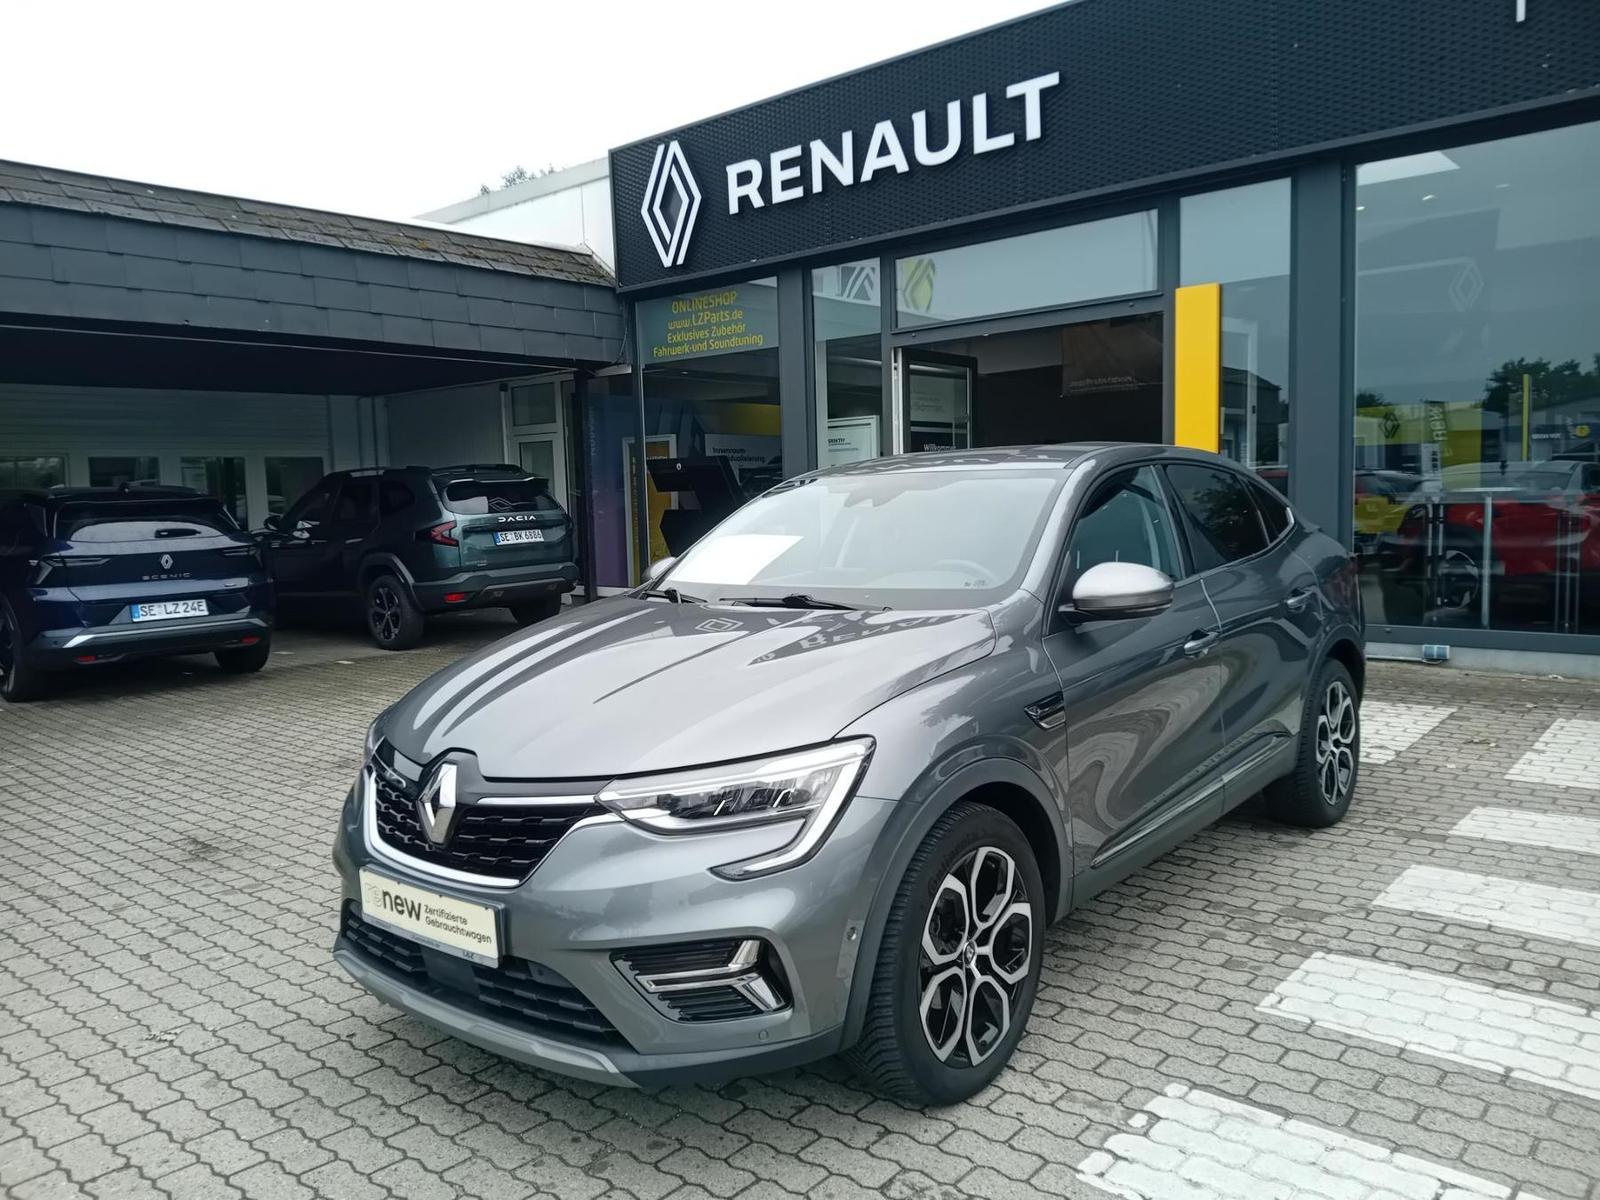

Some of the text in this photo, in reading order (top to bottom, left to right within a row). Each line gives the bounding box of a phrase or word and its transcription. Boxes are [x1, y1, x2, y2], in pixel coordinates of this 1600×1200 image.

[725, 71, 1060, 215] RENAULT
[671, 291, 738, 314] ONLINESHOP
[667, 309, 743, 330] www.LZParts.de
[667, 322, 746, 344] Exklusives Zubehör
[708, 334, 763, 351] Soundtuning
[498, 515, 537, 523] DACIA
[500, 533, 510, 542] SE
[513, 531, 525, 541] BK
[142, 572, 192, 581] SCENIC
[140, 600, 205, 617] SE LZ 24E
[423, 904, 469, 926] Zertifizierte
[424, 916, 493, 945] Gebrauchtwagen
